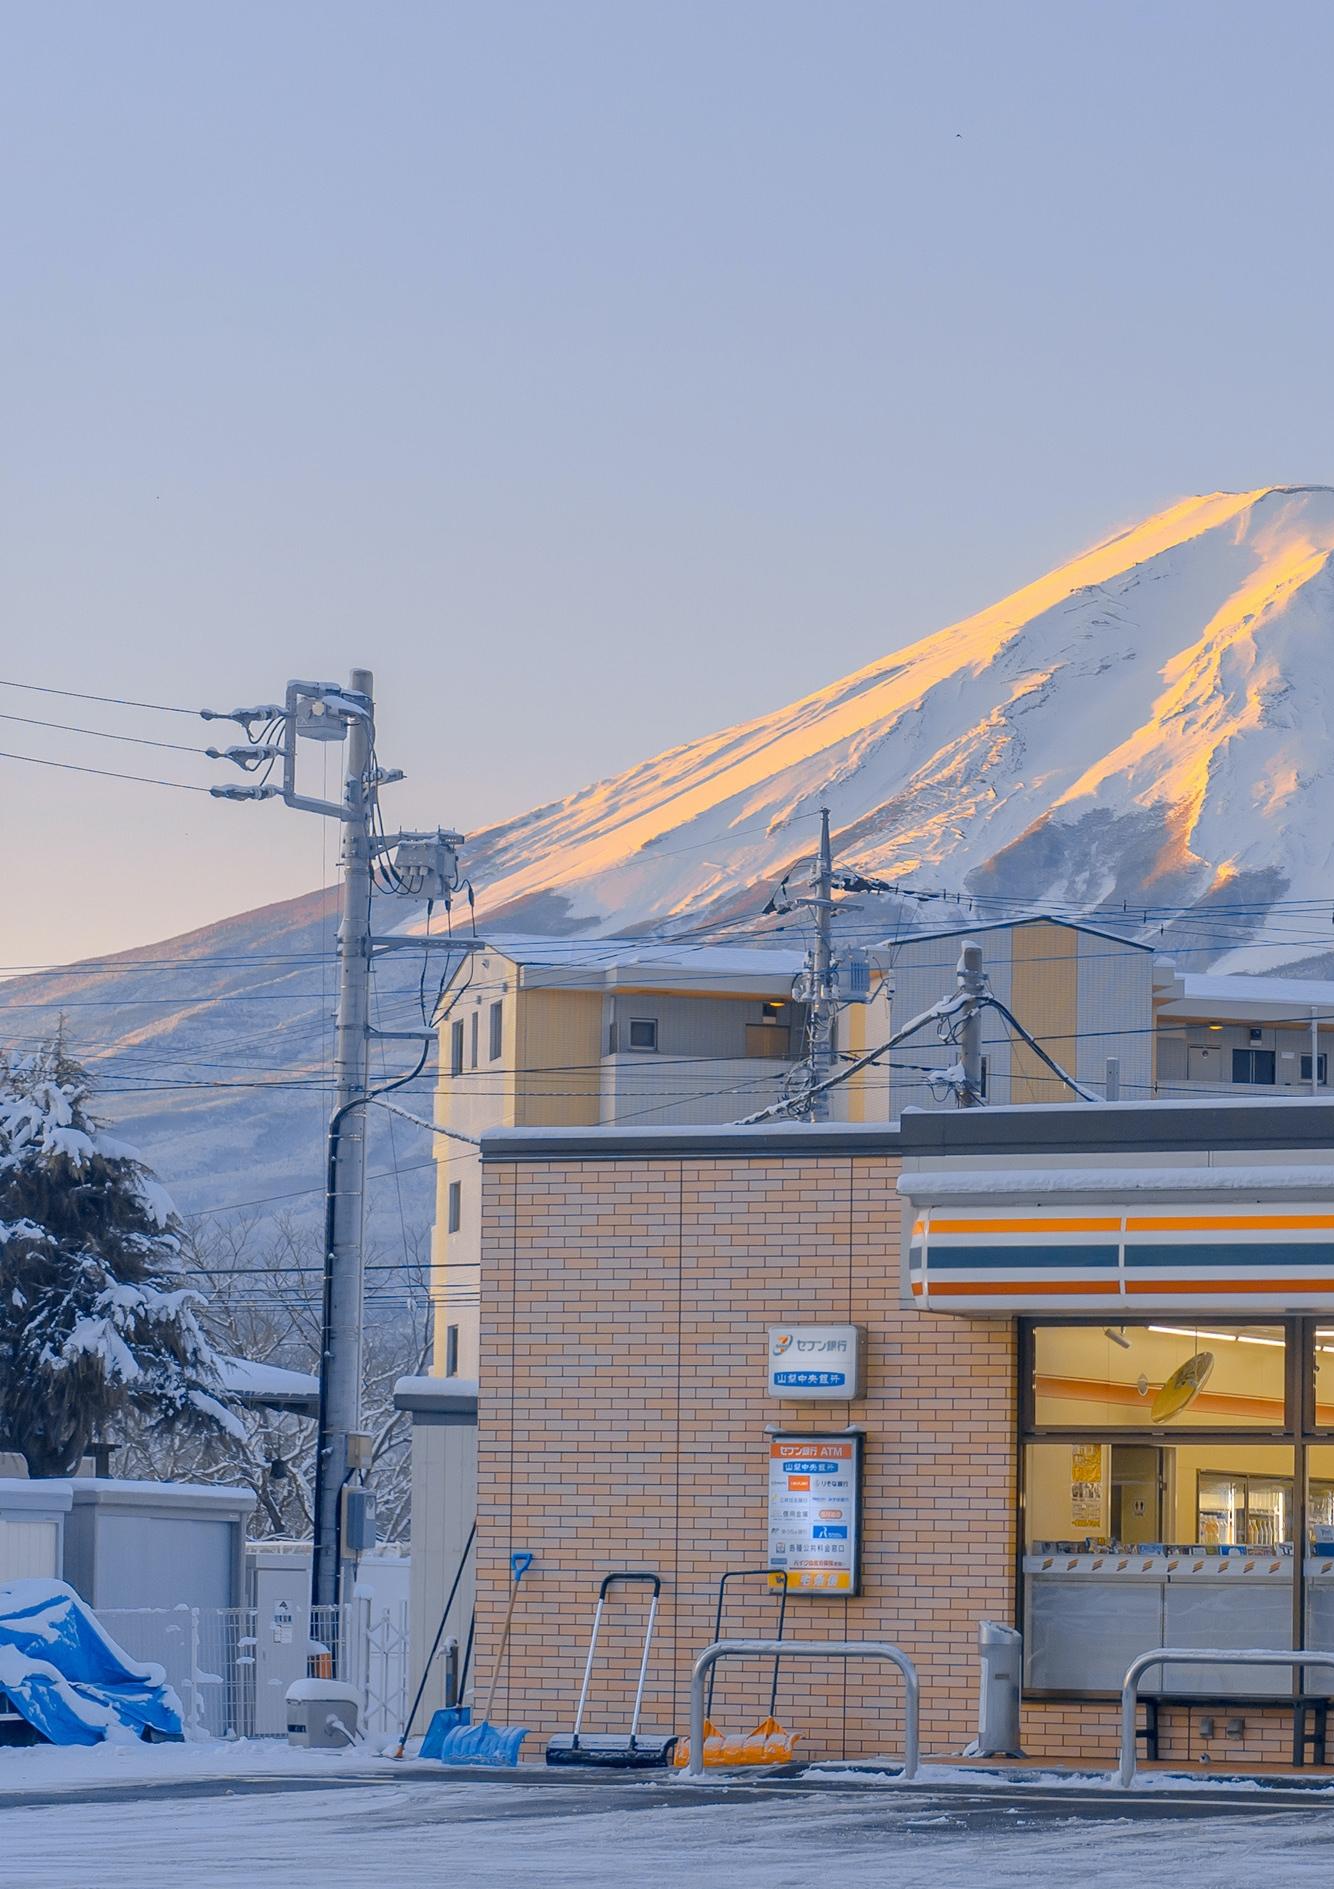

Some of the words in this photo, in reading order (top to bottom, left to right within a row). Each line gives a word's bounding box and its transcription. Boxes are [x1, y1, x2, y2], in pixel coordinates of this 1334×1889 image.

[797, 1340, 848, 1352] セブン銀行
[777, 1373, 841, 1384] 山梨中央銀行
[820, 1447, 843, 1456] ATM
